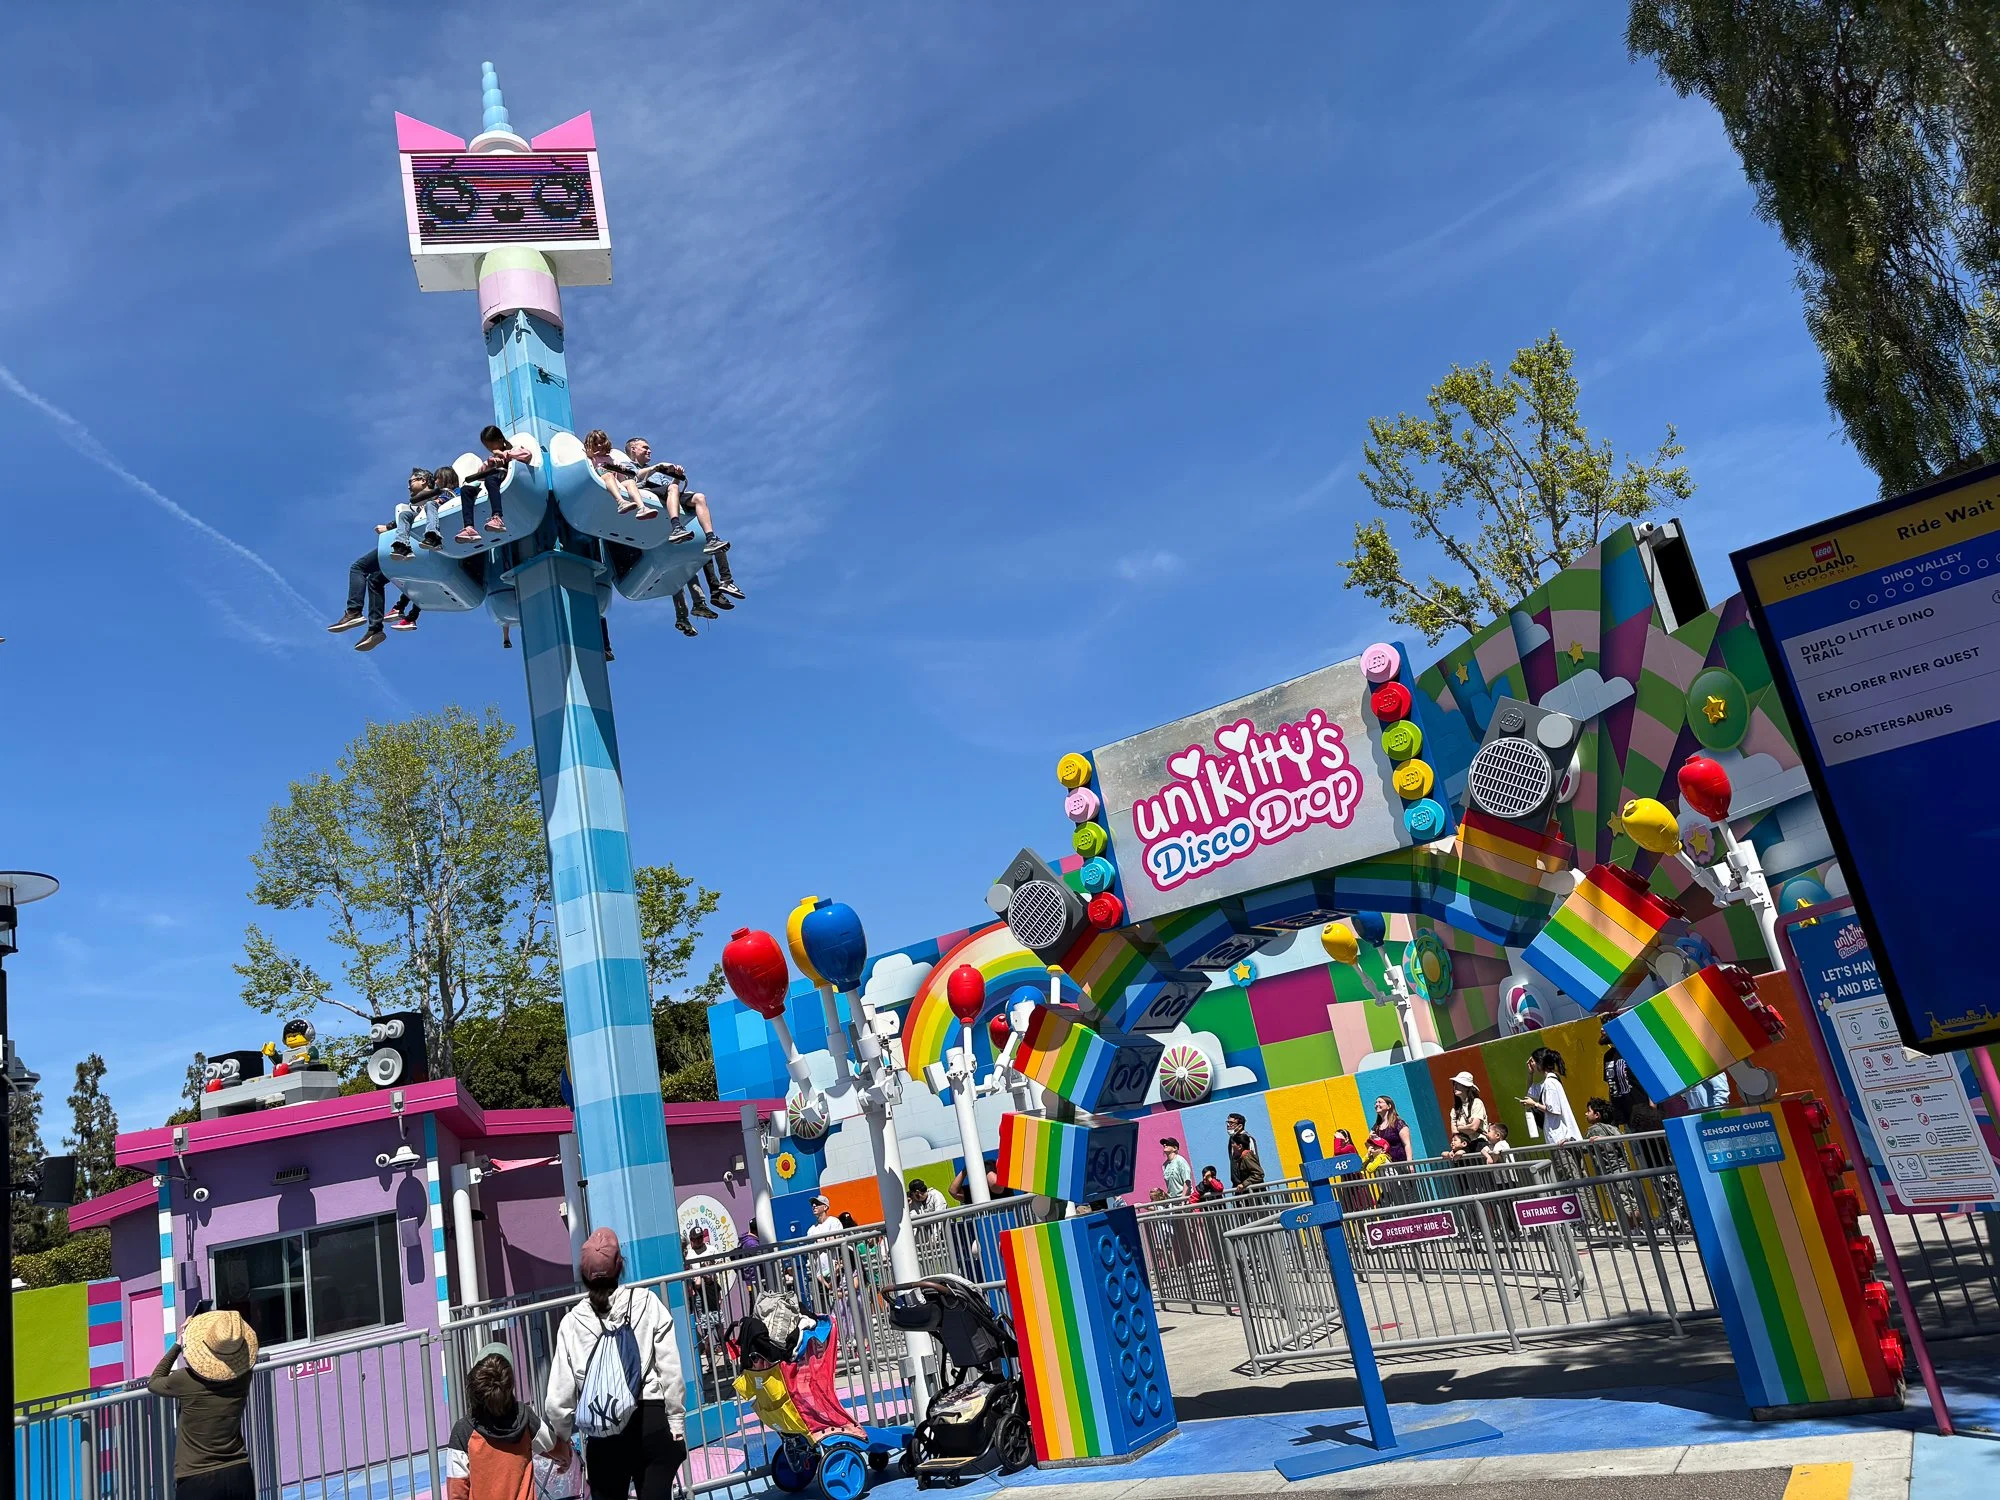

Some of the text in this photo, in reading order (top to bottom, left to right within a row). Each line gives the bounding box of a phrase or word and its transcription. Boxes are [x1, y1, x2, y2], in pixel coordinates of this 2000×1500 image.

[1897, 499, 1994, 541] Ride Wait
[1815, 546, 1832, 557] LEGO
[1783, 539, 1856, 584] LEGOLAND
[1882, 552, 1962, 585] DINO VALLEY
[1786, 564, 1859, 591] CALIFORNIA
[1800, 607, 1935, 656] DUPLO LITTLE DINO
[1368, 653, 1386, 670] LEGO
[1803, 647, 1844, 665] TRAIL
[1817, 646, 1981, 702] EXPLORER RIVER QUEST
[1379, 691, 1397, 710] LEGO
[1500, 712, 1523, 728] LEGO
[1833, 704, 1953, 744] COASTERSAURUS
[1389, 731, 1408, 749] LEGO
[1401, 771, 1420, 788] LEGO
[1153, 775, 1352, 880] Disco Drop
[1412, 809, 1431, 828] LEGO
[1822, 965, 1851, 982] LET'S
[1837, 978, 1877, 997] AND BE
[1702, 1120, 1770, 1137] SENSORY GUIDE
[1521, 1205, 1558, 1218] ENTRANCE
[1386, 1225, 1414, 1236] RESERVE
[1424, 1221, 1439, 1231] RIDE
[588, 1393, 622, 1432] NY
